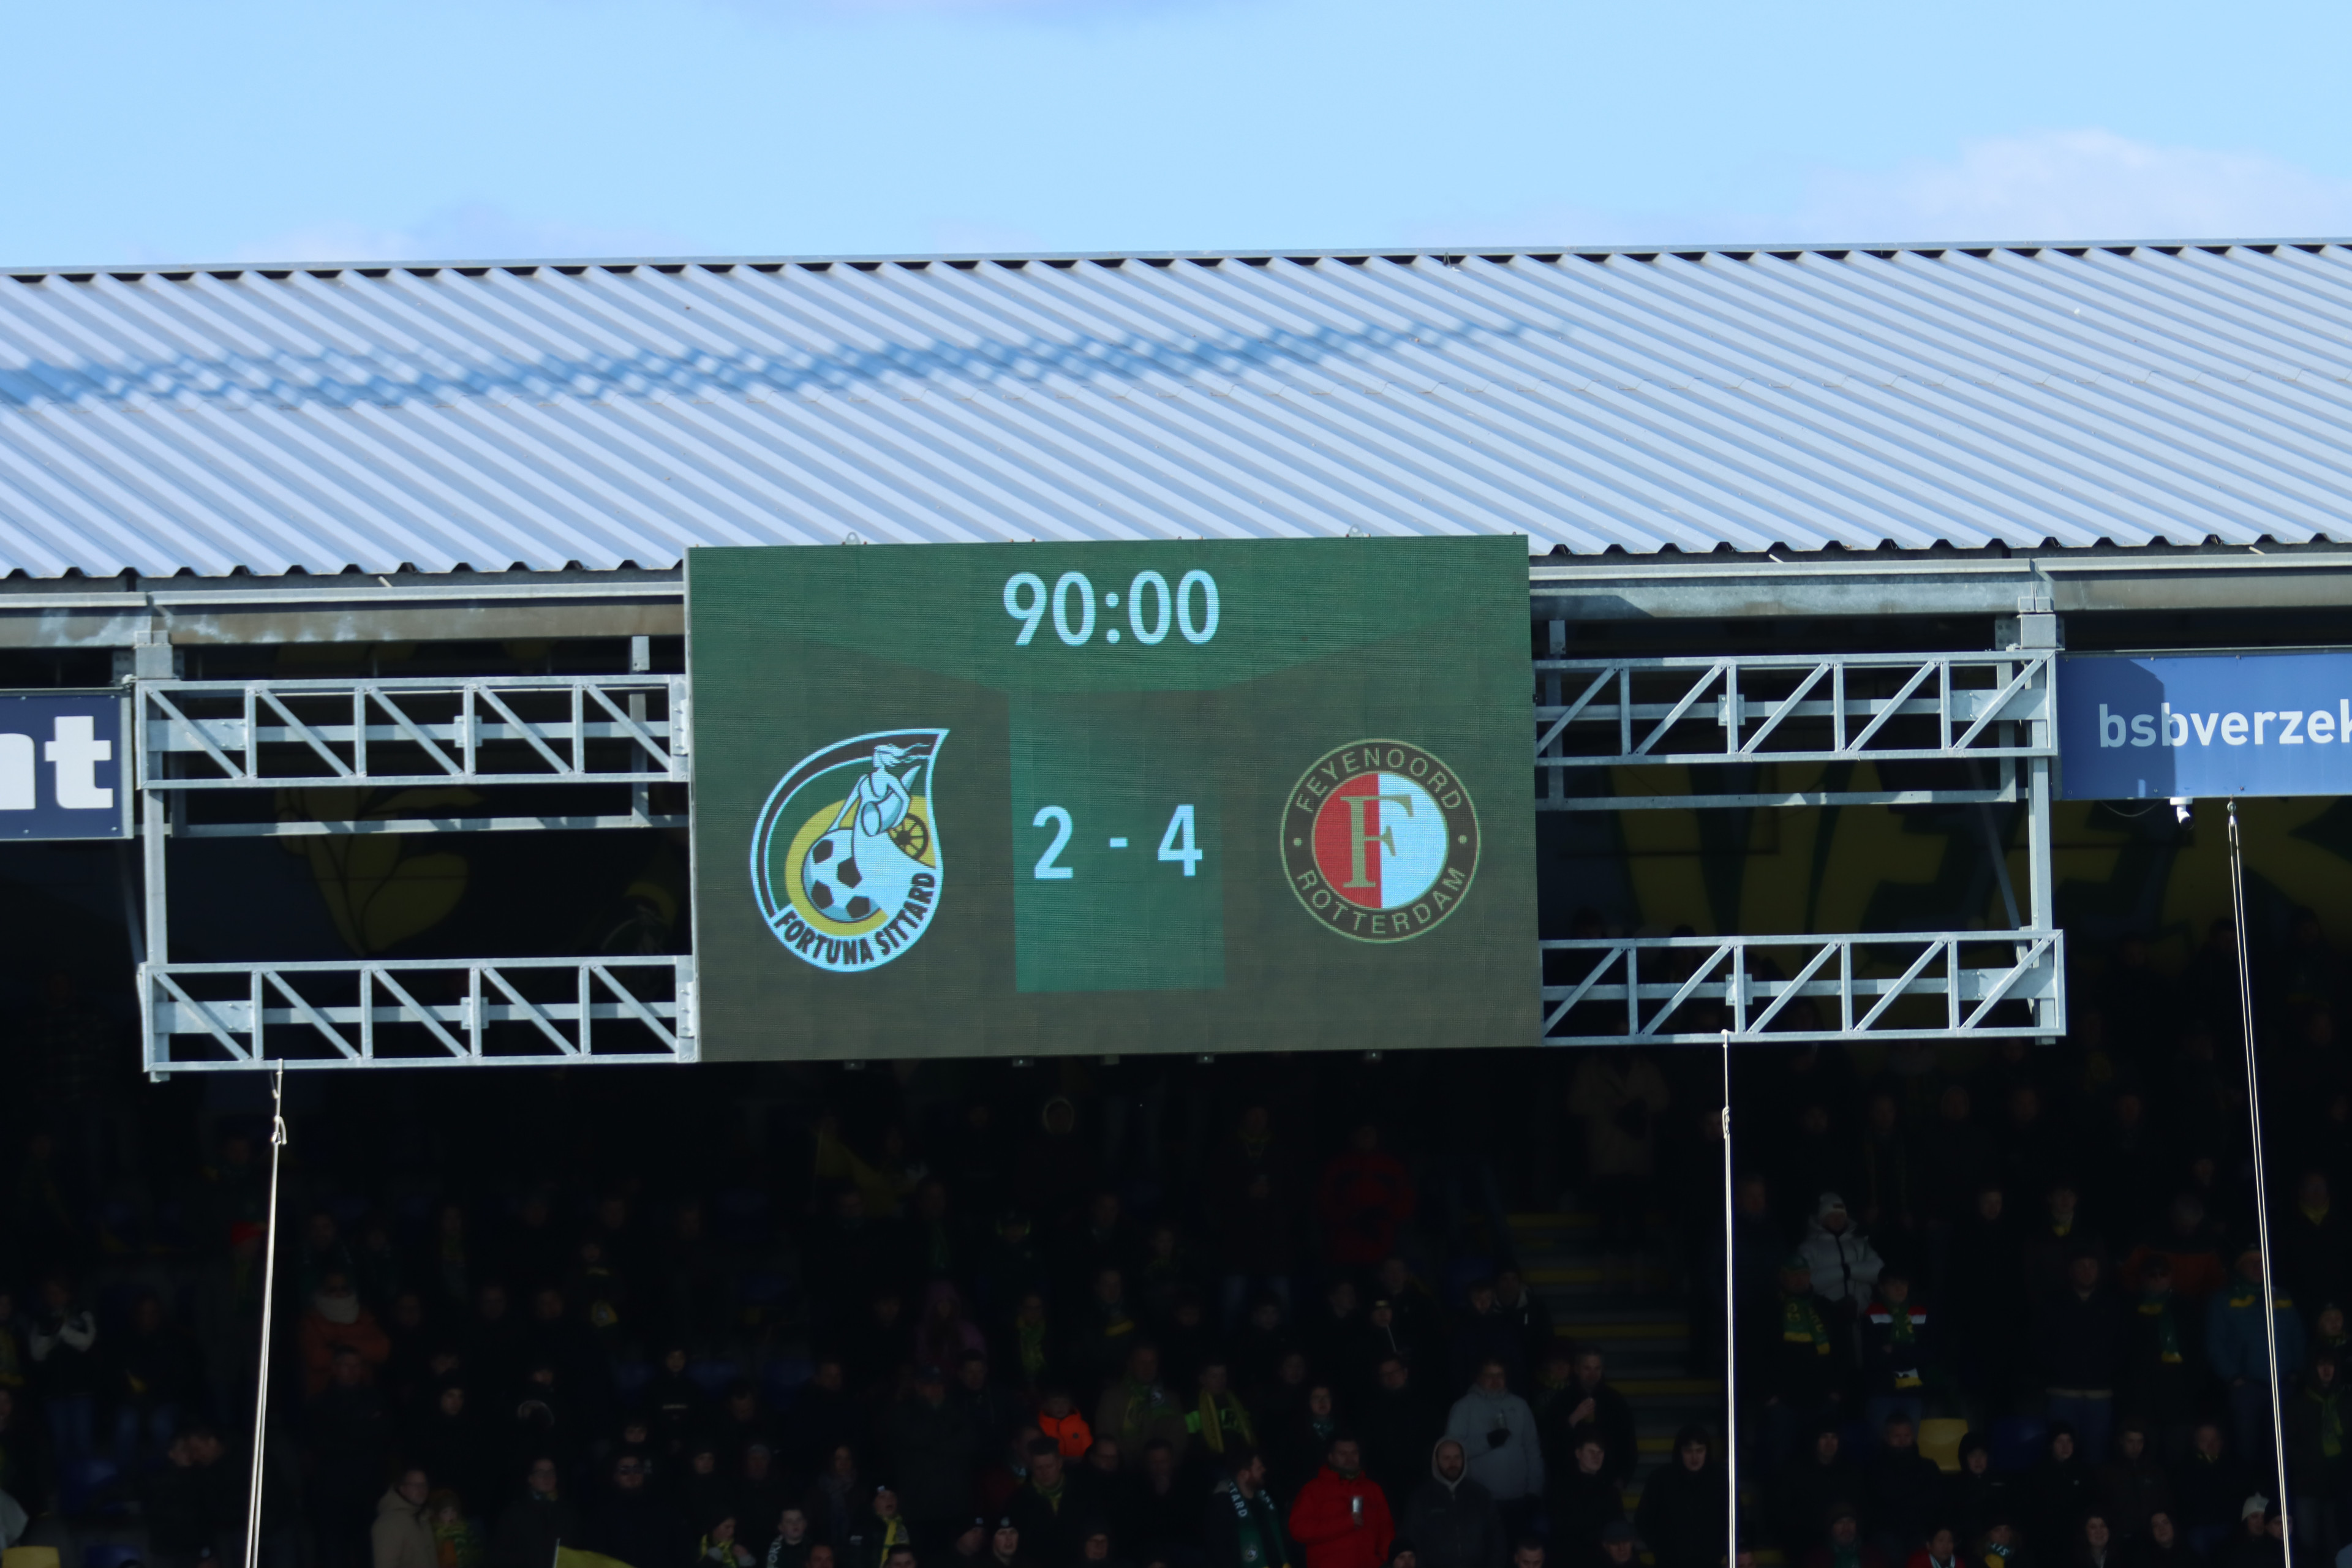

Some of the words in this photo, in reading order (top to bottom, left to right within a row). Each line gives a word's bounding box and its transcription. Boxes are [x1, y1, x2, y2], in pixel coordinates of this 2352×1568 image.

[1003, 569, 1220, 646] 90:00
[1296, 748, 1462, 813] FEYENOORD
[1033, 805, 1073, 879] 2
[1109, 837, 1128, 848] -
[1158, 804, 1203, 876] 4
[1340, 795, 1414, 888] F
[774, 911, 875, 965] FORTUNA
[875, 873, 935, 955] SITTARD
[1297, 867, 1466, 933] ROTTERDAM
